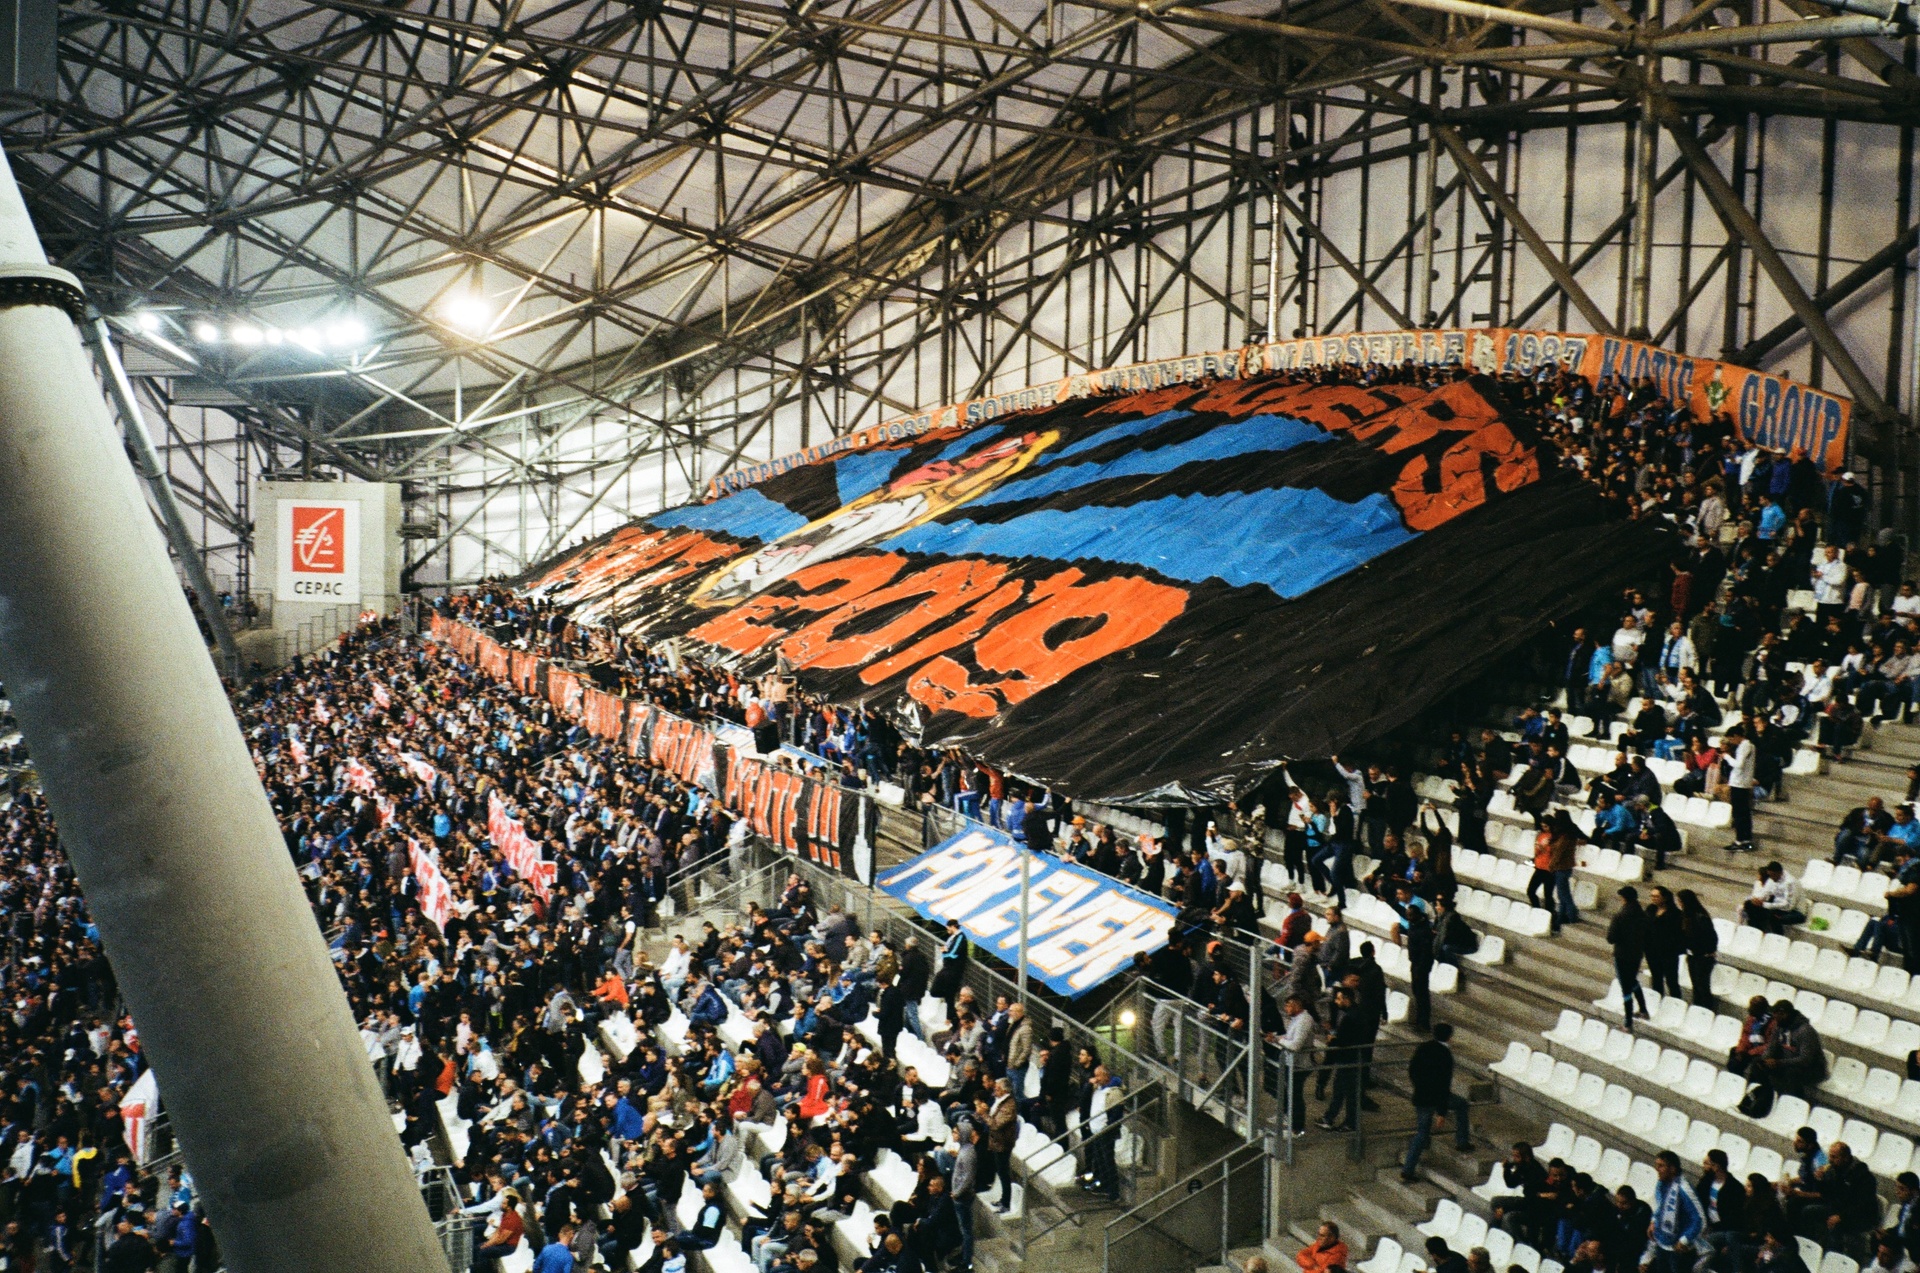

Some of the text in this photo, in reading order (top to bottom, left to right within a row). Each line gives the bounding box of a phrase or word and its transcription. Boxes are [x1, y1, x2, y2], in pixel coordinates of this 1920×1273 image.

[877, 415, 931, 442] 1987
[966, 384, 1059, 424] SOUTH
[1100, 351, 1239, 392] WINNERS
[1270, 331, 1466, 369] MARSEILLE
[1502, 332, 1588, 376] 1987
[1740, 372, 1842, 470] GROUP
[294, 581, 343, 595] CEPAC
[686, 555, 1190, 718] 2019
